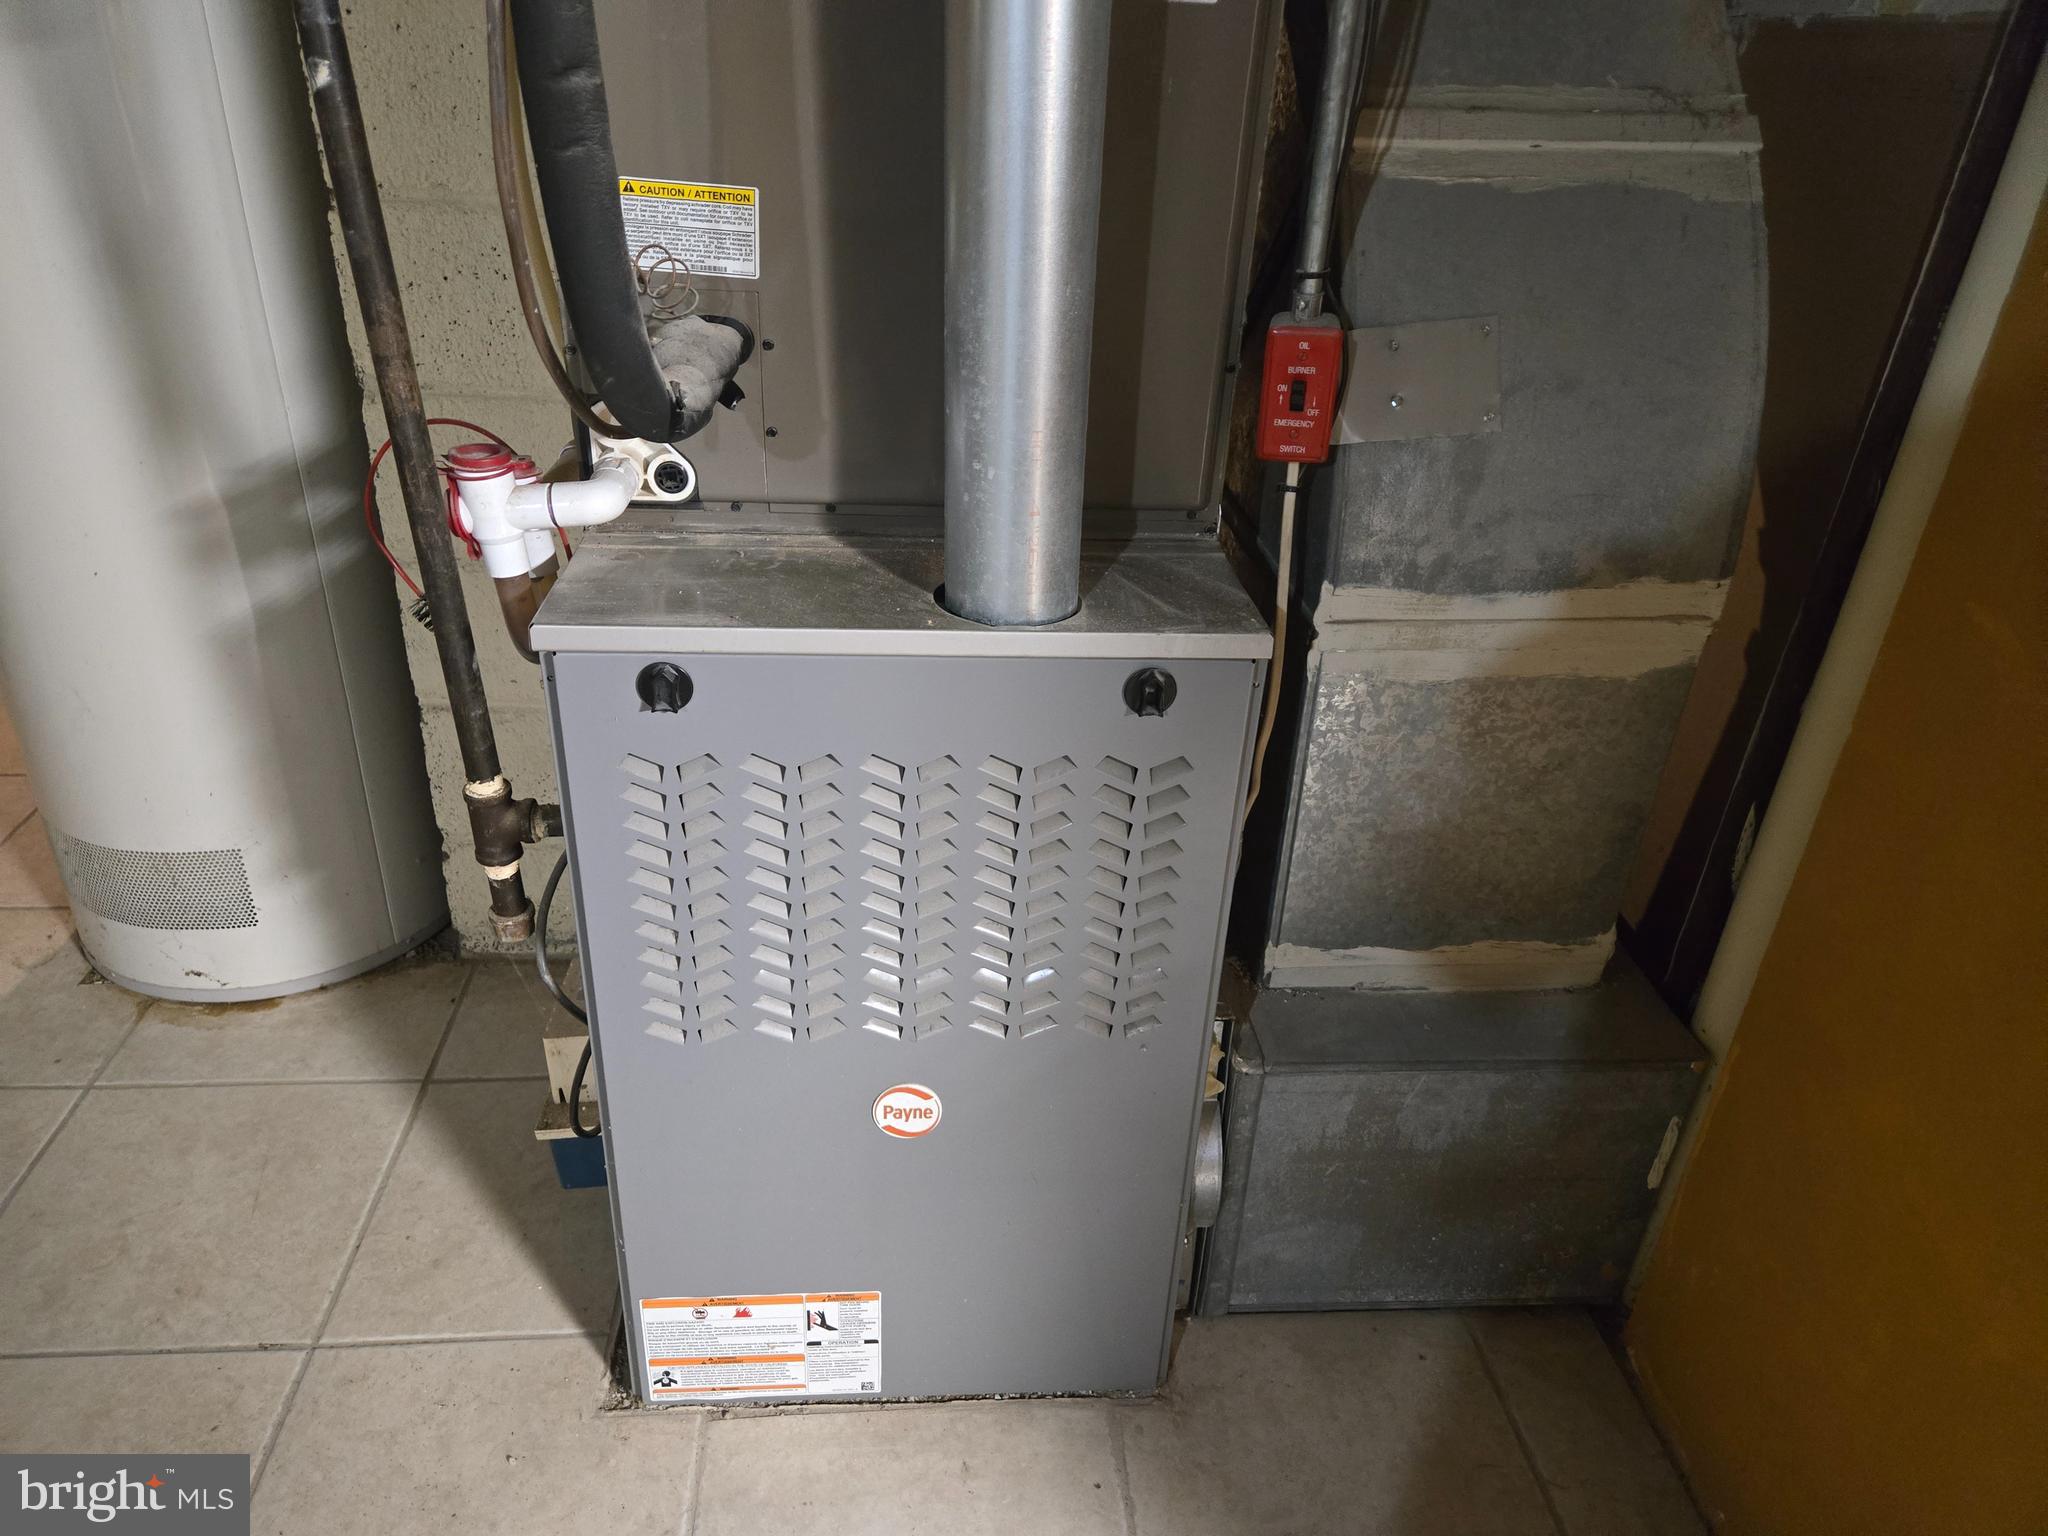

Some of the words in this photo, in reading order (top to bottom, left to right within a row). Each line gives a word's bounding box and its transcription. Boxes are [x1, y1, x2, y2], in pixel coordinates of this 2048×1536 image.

[640, 185, 685, 197] CAUTION
[688, 189, 692, 198] /
[695, 190, 751, 203] ATTENTION
[1299, 342, 1310, 350] OIL
[1288, 366, 1316, 375] BURNER
[1277, 384, 1288, 392] ON
[1307, 408, 1320, 417] OFF
[1274, 418, 1315, 428] EMERGENCY
[1280, 445, 1306, 454] SWITCH
[883, 1105, 934, 1122] Payne
